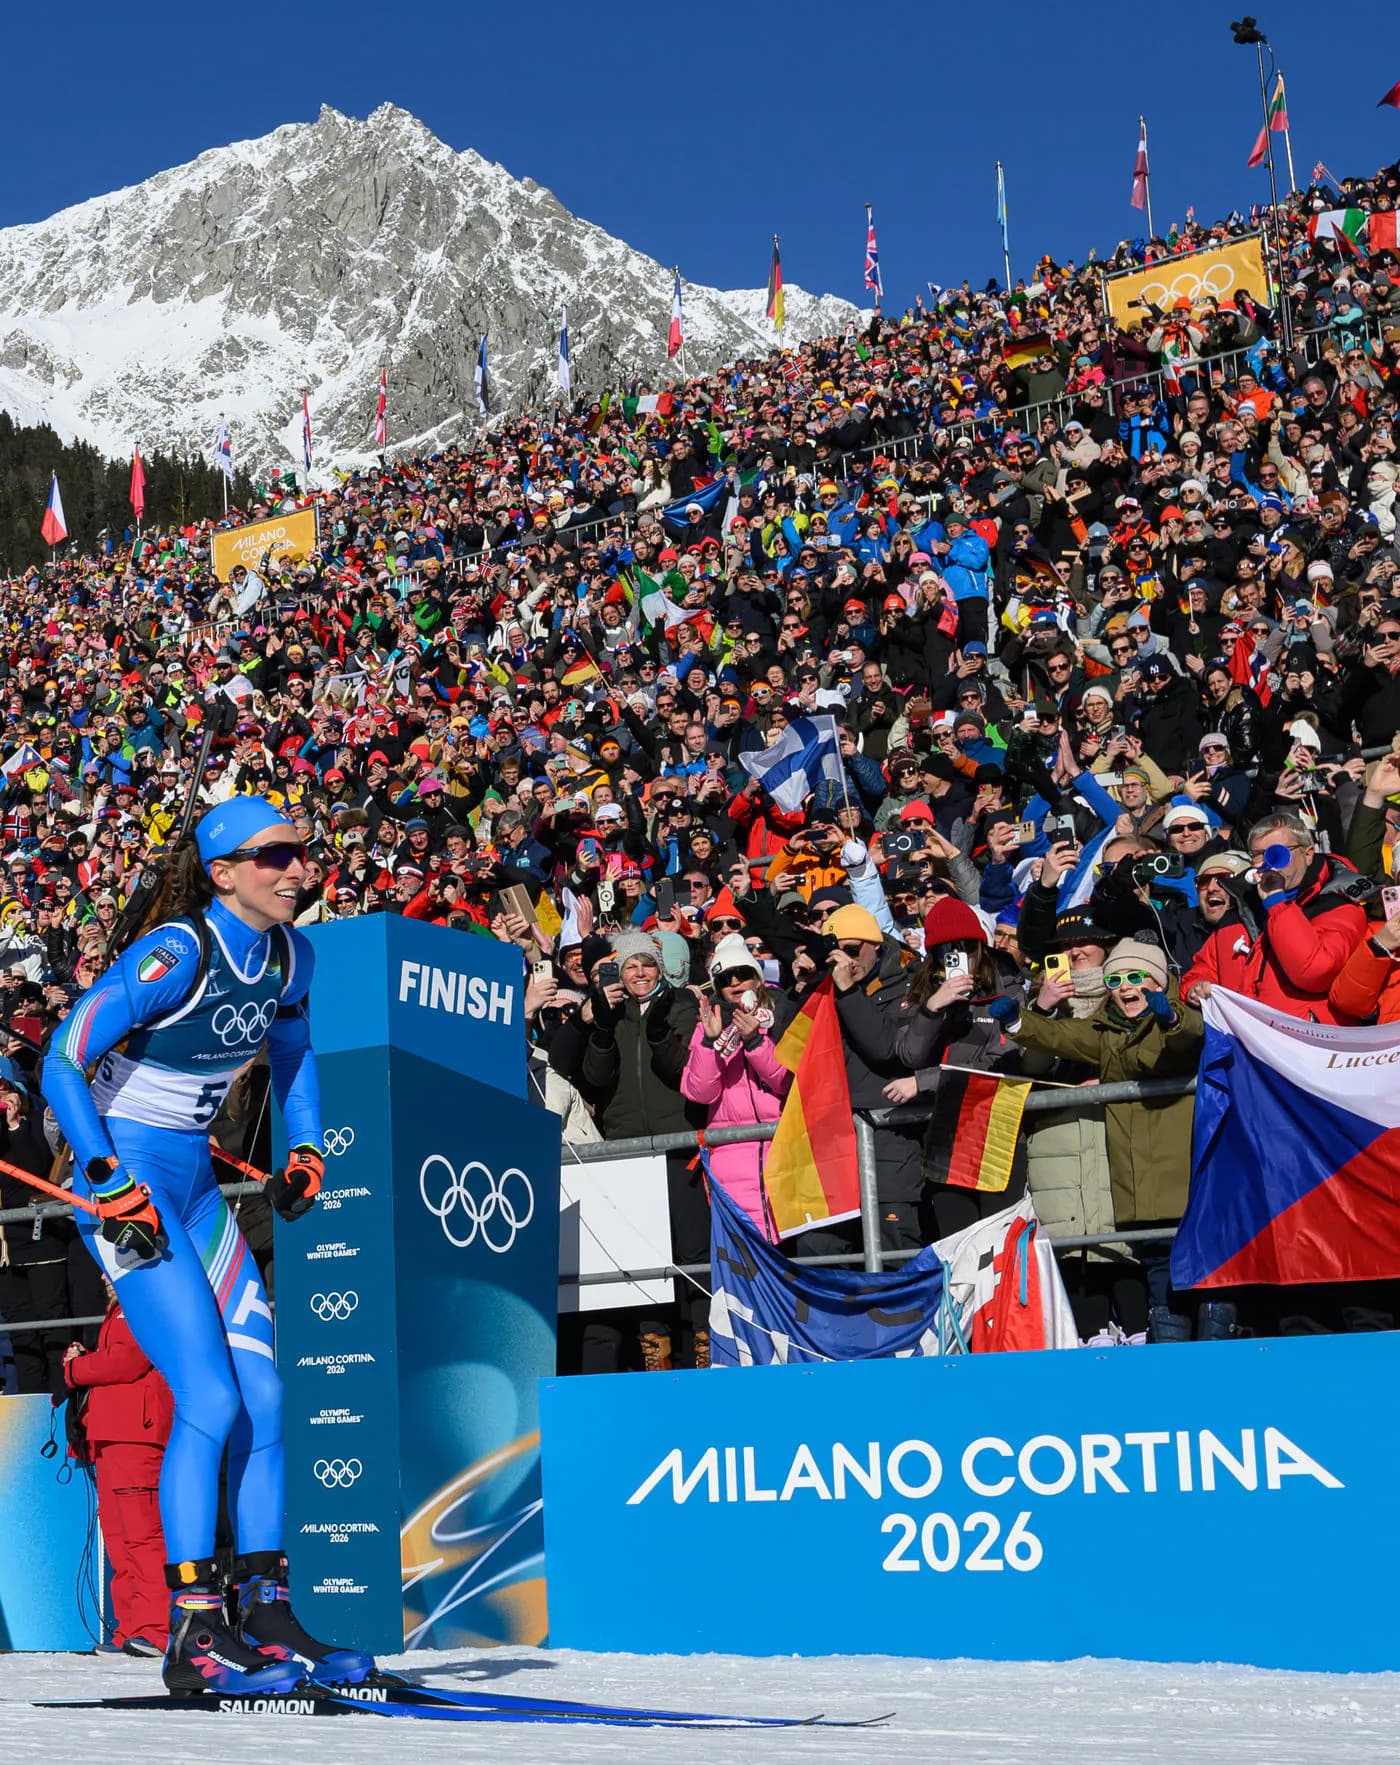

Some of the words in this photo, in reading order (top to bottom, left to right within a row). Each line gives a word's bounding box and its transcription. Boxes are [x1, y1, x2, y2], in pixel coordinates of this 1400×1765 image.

[231, 527, 286, 551] MILANO
[241, 539, 296, 561] CORA
[155, 947, 177, 966] ITALIA
[399, 960, 514, 1025] FINISH
[102, 1056, 114, 1082] 5
[194, 1081, 228, 1124] 5
[332, 1187, 372, 1199] CORTINA
[323, 1200, 342, 1210] 2026
[316, 1243, 347, 1252] OLYMPIC
[306, 1250, 332, 1260] WINTER
[297, 1356, 335, 1367] MILANO
[336, 1354, 375, 1365] CORTINA
[326, 1365, 346, 1375] 2026
[320, 1409, 350, 1417] OLYMPIC
[310, 1416, 336, 1425] WINTER
[626, 1440, 943, 1505] MILANO
[961, 1427, 1345, 1497] CORTINA
[300, 1524, 338, 1533] MILANO
[339, 1523, 379, 1532] CORTINA
[330, 1534, 349, 1543] 2026
[880, 1511, 1043, 1572] 2026
[207, 1650, 248, 1673] SALOMON
[218, 1700, 315, 1715] SALOMON
